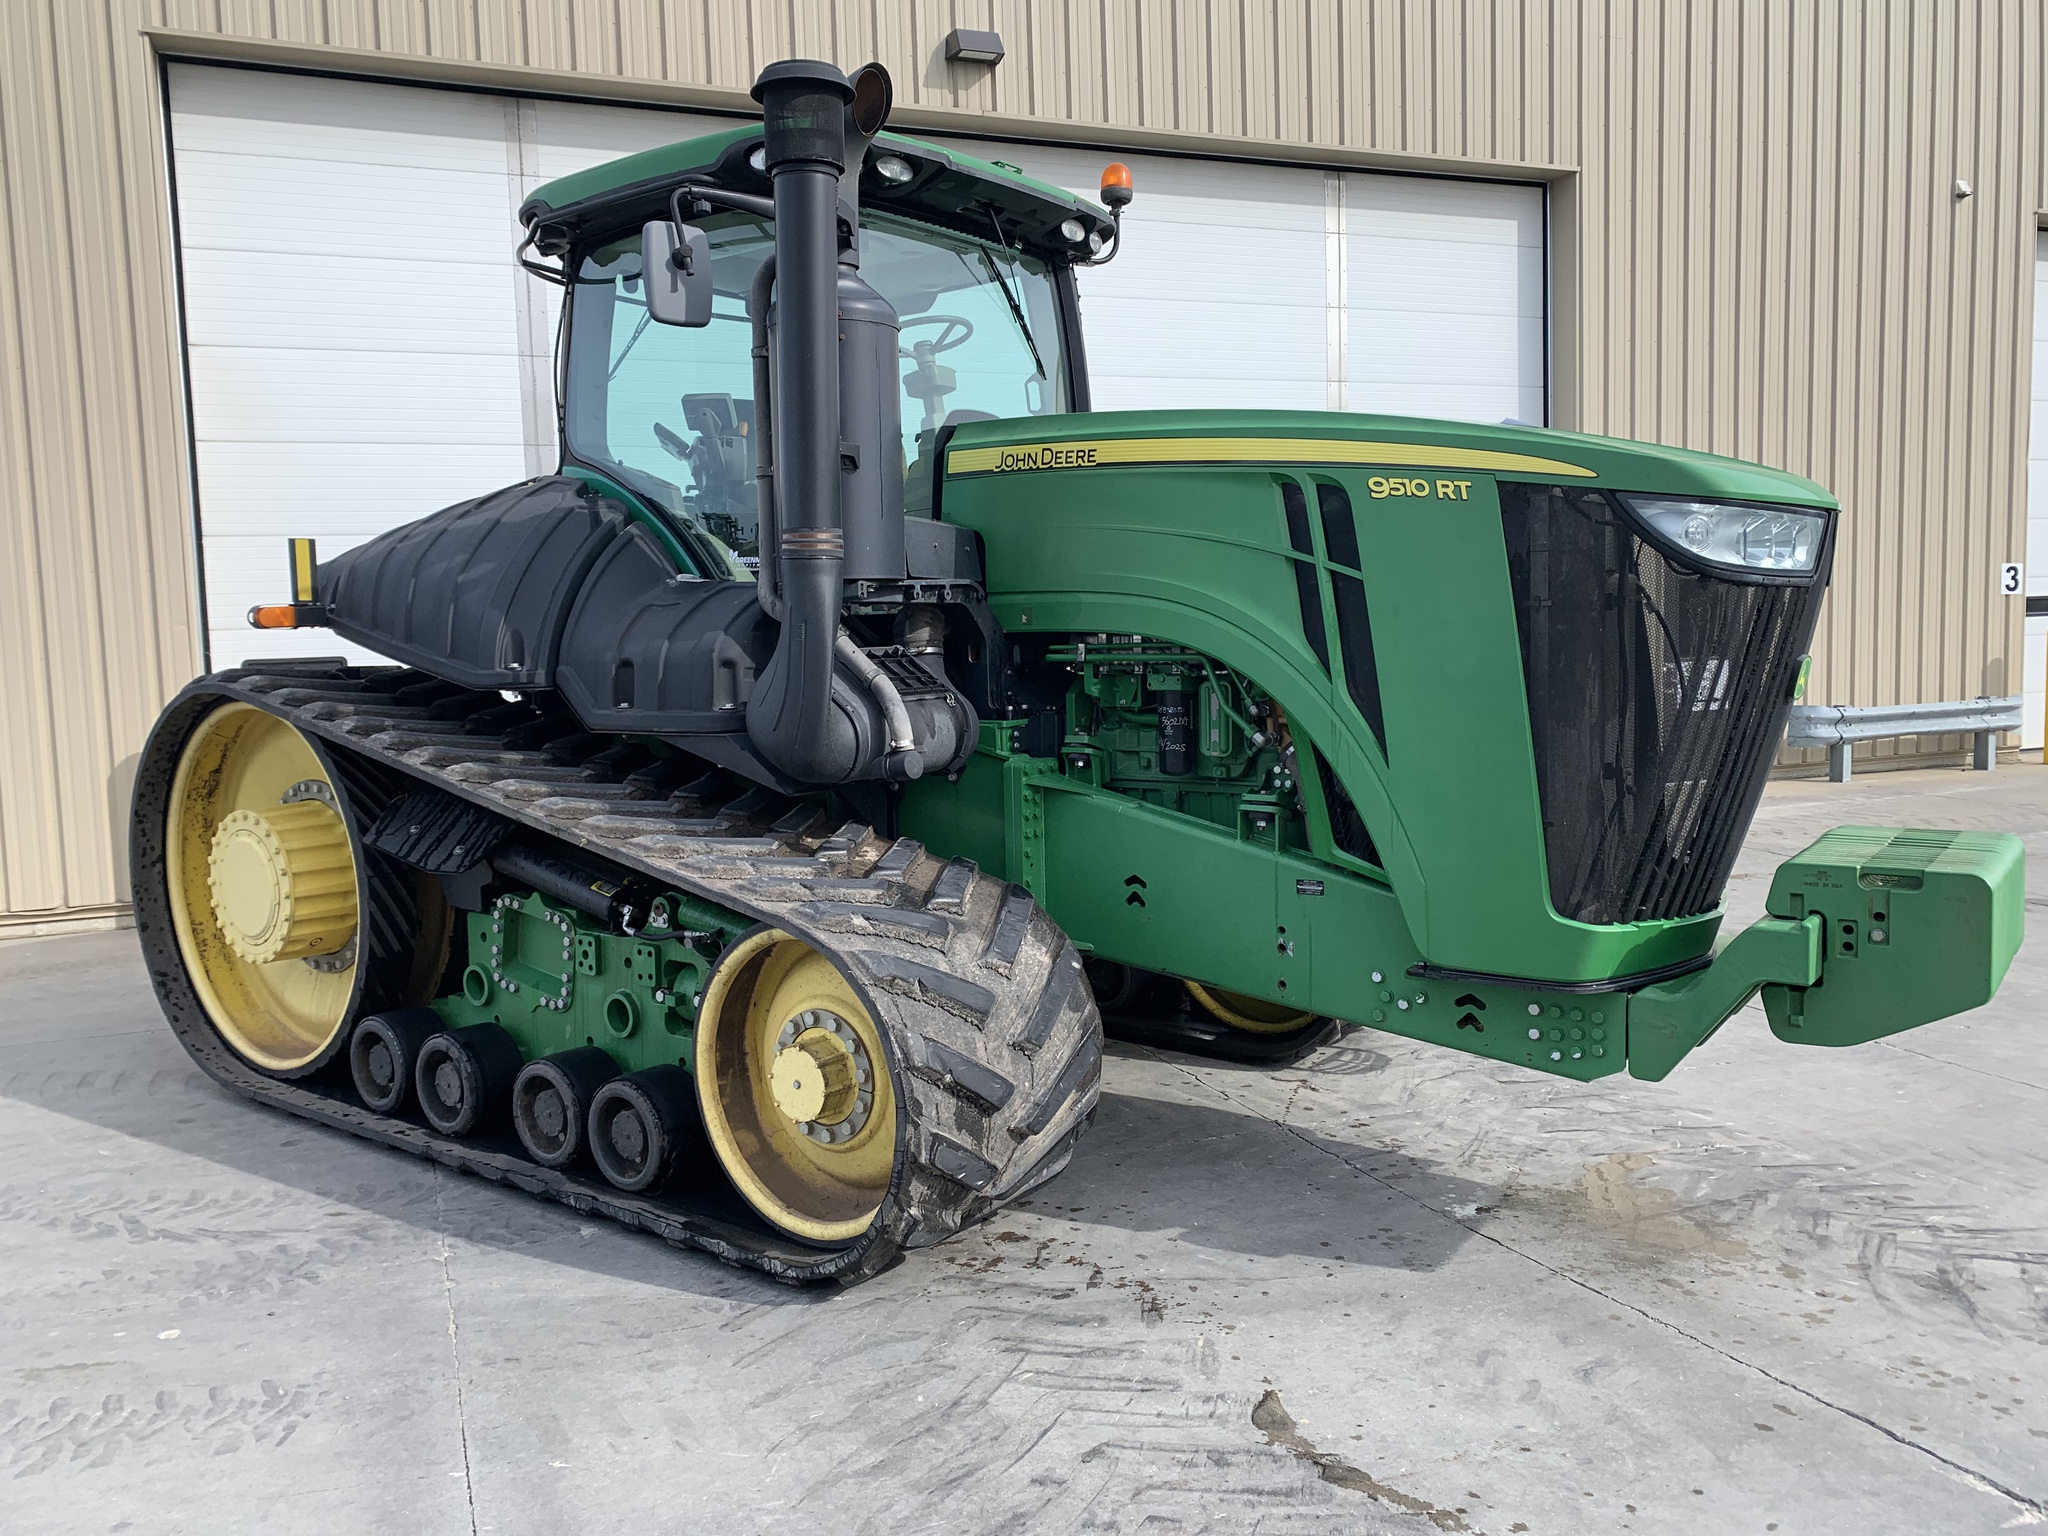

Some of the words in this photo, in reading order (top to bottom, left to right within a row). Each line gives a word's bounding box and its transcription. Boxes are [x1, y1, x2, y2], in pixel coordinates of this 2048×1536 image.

[994, 450, 1038, 469] JOHN
[1041, 447, 1098, 466] DEERE
[1367, 476, 1431, 499] 9510
[1435, 479, 1472, 501] RT
[2005, 565, 2020, 592] 3
